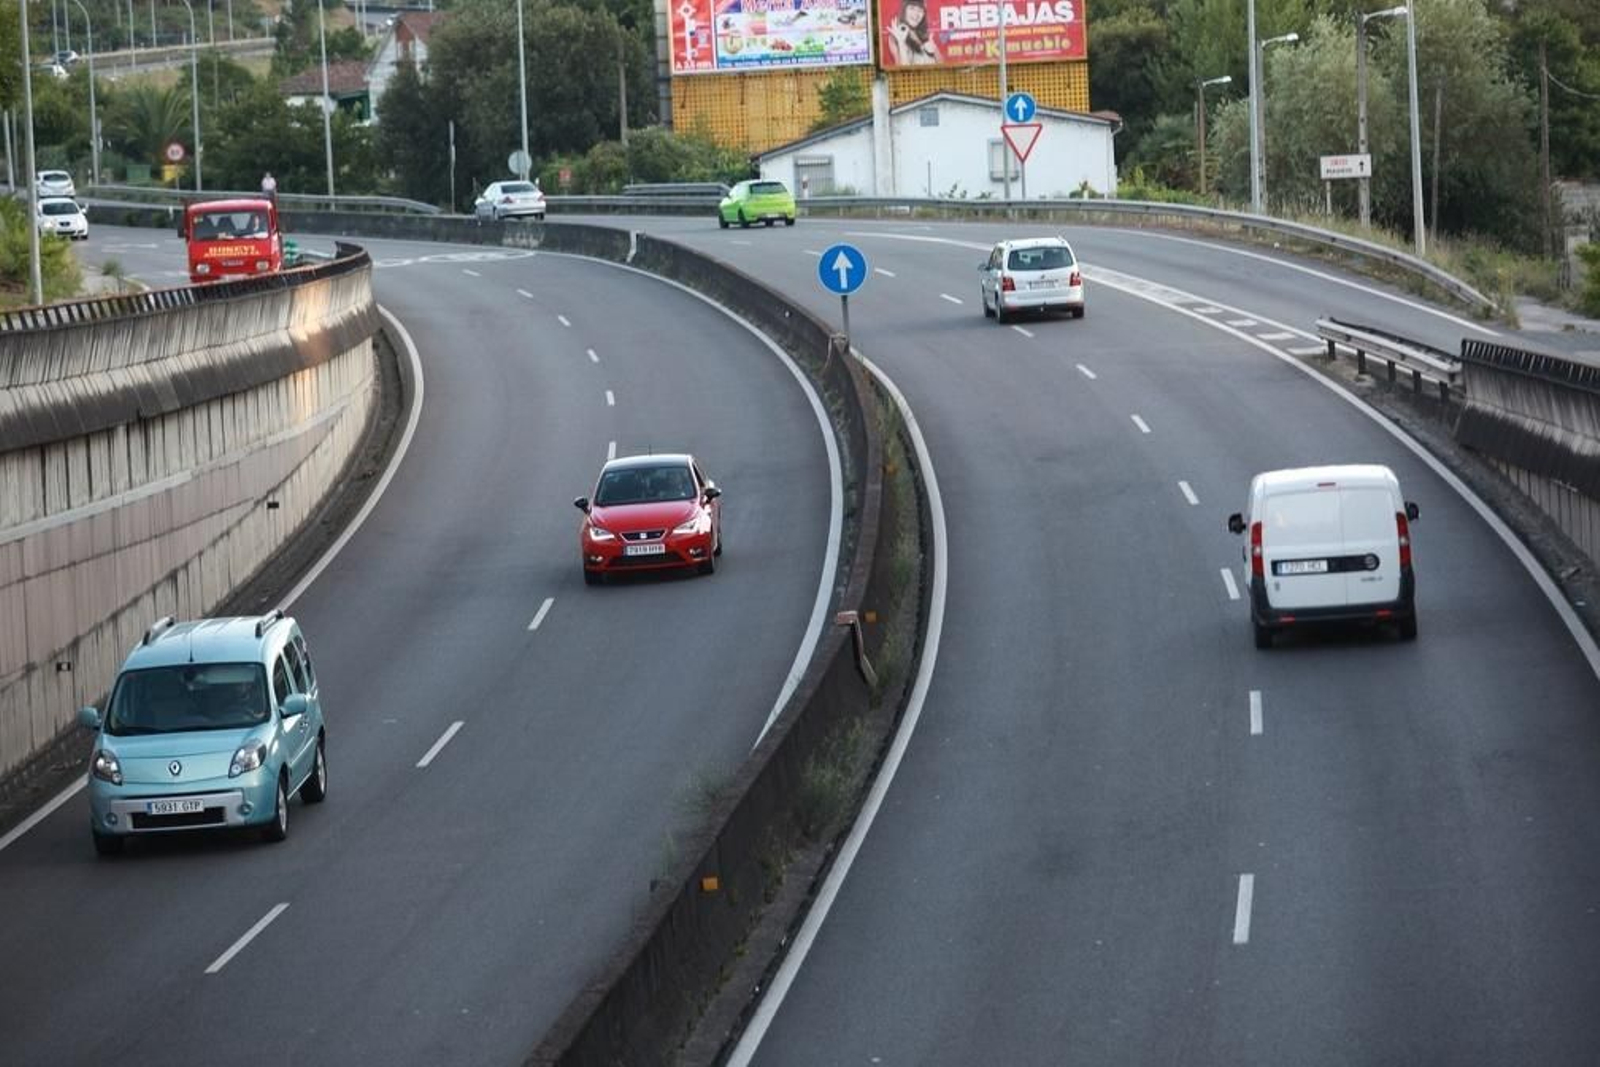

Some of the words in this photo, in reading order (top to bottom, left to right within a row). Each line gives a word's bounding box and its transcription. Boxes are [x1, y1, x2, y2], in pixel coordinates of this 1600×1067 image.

[939, 1, 1075, 31] REBAJAS
[154, 802, 177, 812] 5931
[182, 801, 200, 811] GTP
